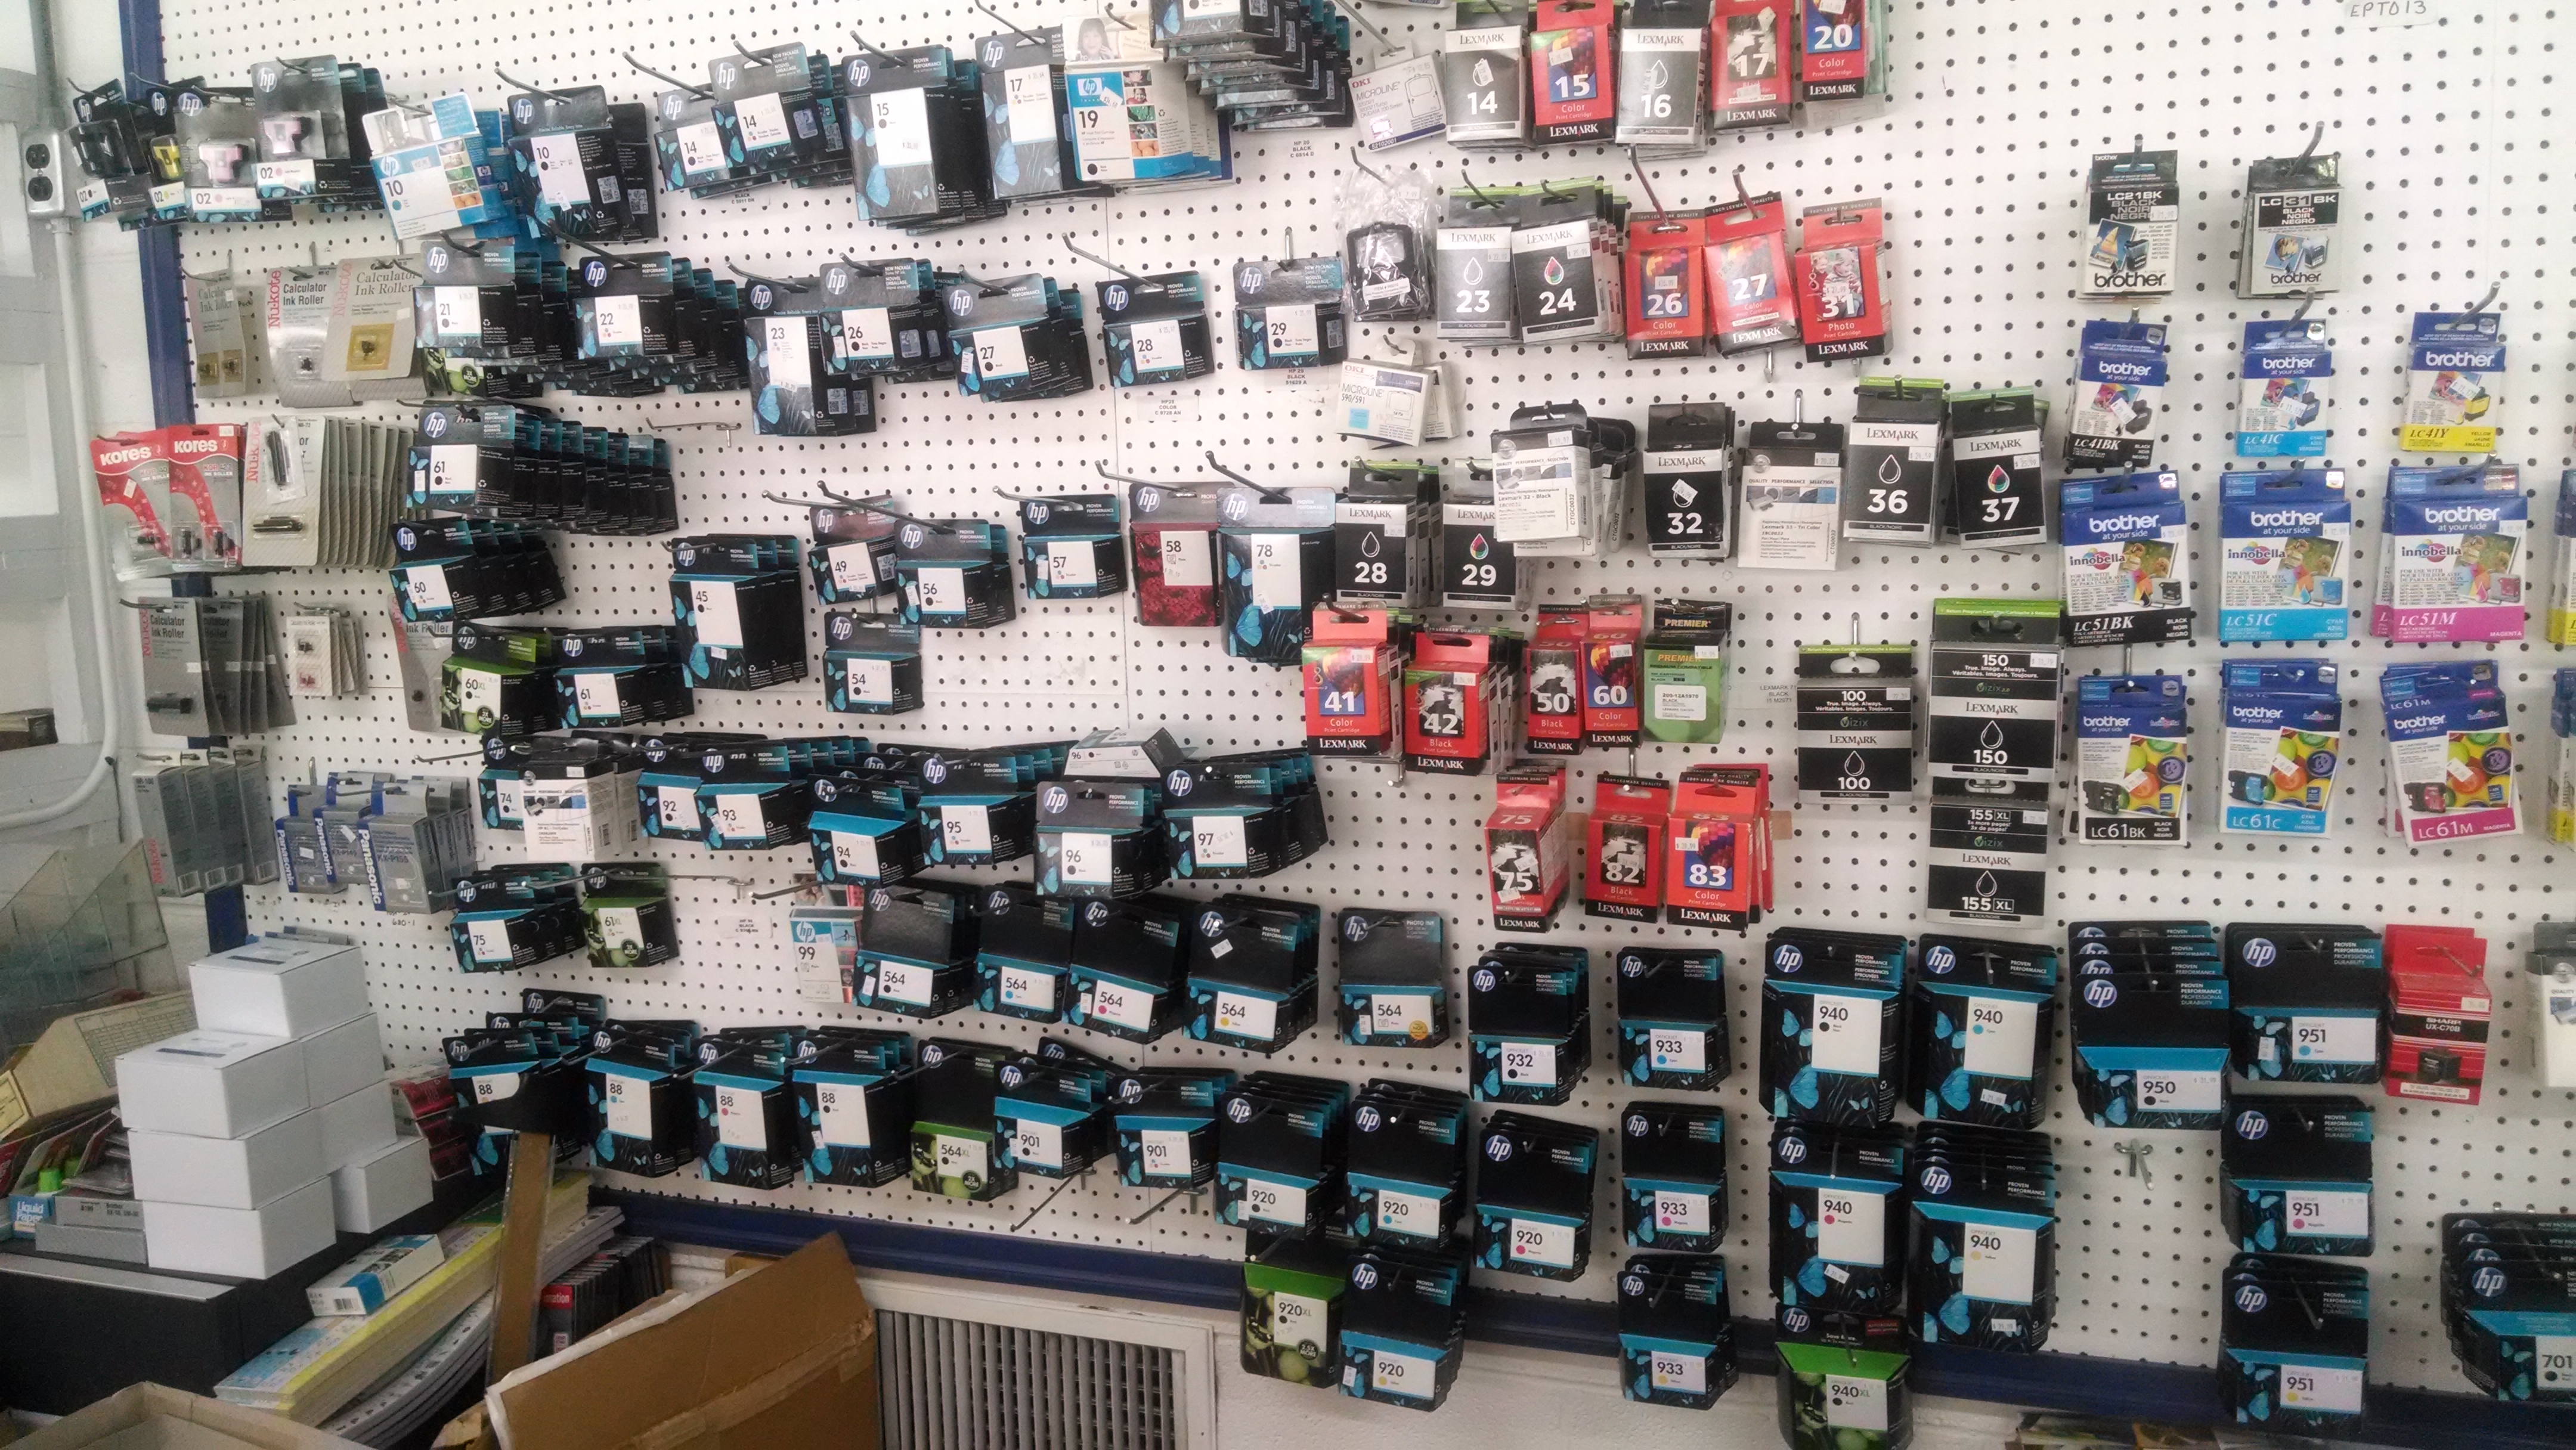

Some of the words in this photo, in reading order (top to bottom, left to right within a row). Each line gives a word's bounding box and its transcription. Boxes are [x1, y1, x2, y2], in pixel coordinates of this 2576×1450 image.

[1460, 34, 1504, 45] LEXMARK
[1814, 24, 1853, 49] 20
[1735, 53, 1769, 77] 17
[1010, 79, 1023, 92] 17
[1352, 78, 1371, 88] OKI
[1555, 73, 1590, 97] 15
[1810, 83, 1856, 95] LEXMARK
[877, 103, 889, 116] 15
[1467, 91, 1498, 115] 14
[1642, 94, 1671, 117] 16
[744, 116, 757, 128] 14
[1079, 110, 1098, 128] 19
[537, 147, 550, 159] 10
[684, 141, 697, 154] 14
[260, 167, 274, 179] 02
[385, 181, 403, 197] 10
[196, 193, 211, 205] 02
[2107, 191, 2162, 201] LC21BK
[2094, 272, 2165, 287] brother
[2271, 272, 2320, 284] brother
[283, 283, 326, 293] Calculator
[1733, 274, 1767, 300] 27
[283, 296, 296, 305] Ink
[299, 295, 324, 305] Roller
[1456, 290, 1490, 313] 23
[1539, 288, 1576, 315] 24
[1648, 293, 1683, 315] 26
[1822, 294, 1854, 317] 31
[439, 303, 450, 315] 21
[600, 314, 614, 325] 22
[771, 327, 785, 339] 23
[848, 327, 863, 339] 26
[1271, 323, 1287, 335] 29
[1137, 339, 1153, 352] 28
[1641, 341, 1689, 352] LEXMARK
[980, 346, 994, 359] 27
[2426, 351, 2493, 368] brother
[2100, 361, 2150, 376] brother
[1342, 383, 1382, 397] MICROLINE
[1342, 394, 1365, 404] 590/591
[434, 461, 445, 473] 61
[1867, 489, 1908, 514] 36
[1349, 509, 1392, 519] LEXMARK
[1982, 497, 2020, 522] 37
[2426, 507, 2498, 523] brother
[1667, 513, 1703, 534] 32
[2089, 515, 2159, 533] brother
[2296, 526, 2310, 534] side
[1166, 541, 1182, 553] 58
[1256, 545, 1272, 557] 78
[2070, 552, 2126, 566] innobella
[2228, 549, 2285, 561] innobella
[835, 561, 847, 572] 49
[1052, 556, 1066, 568] 57
[1354, 562, 1388, 584] 28
[1462, 564, 1497, 586] 29
[414, 582, 426, 593] 60
[924, 583, 937, 594] 56
[696, 591, 708, 602] 45
[1982, 655, 2009, 665] 150
[852, 674, 866, 685] 54
[580, 688, 591, 699] 61
[1593, 687, 1627, 705] 60
[1324, 692, 1354, 712] 41
[1537, 693, 1569, 713] 50
[1423, 714, 1460, 735] 42
[2084, 716, 2131, 729] brother
[1319, 738, 1367, 750] LEXMARK
[1429, 739, 1453, 748] Black
[1829, 735, 1877, 745] LEXMARK
[1417, 756, 1463, 770] LEXMARK
[1974, 750, 2008, 764] 150
[1838, 777, 1871, 789] 100
[500, 794, 512, 804] 74
[663, 801, 676, 811] 92
[723, 810, 736, 820] 93
[1970, 809, 1992, 820] 155
[947, 822, 962, 834] 95
[315, 818, 333, 875] Panasonic
[1198, 834, 1213, 846] 97
[837, 845, 851, 858] 94
[1066, 850, 1081, 862] 96
[1962, 853, 2011, 865] LEXMARK
[359, 829, 382, 904] Panasonic
[1606, 863, 1639, 884] 82
[1690, 865, 1726, 886] 83
[1501, 872, 1532, 891] 75
[1962, 897, 1991, 910] 155
[1996, 900, 2012, 909] XL
[605, 916, 621, 927] 61XL
[1681, 909, 1731, 922] LEXMARK
[473, 935, 486, 946] 75
[798, 947, 815, 959] 99
[884, 971, 905, 985] 564
[1005, 978, 1027, 991] 564
[1100, 993, 1122, 1006] 564
[1221, 1003, 1245, 1017] 564
[1377, 1005, 1402, 1015] 564
[1820, 1006, 1848, 1021] 940
[1974, 1009, 2002, 1024] 940
[2299, 1029, 2326, 1042] 951
[1656, 1040, 1682, 1053] 933
[1507, 1054, 1533, 1067] 932
[479, 1085, 493, 1095] 88
[610, 1084, 623, 1095] 88
[2143, 1082, 2176, 1093] 950
[720, 1095, 733, 1107] 88
[822, 1093, 835, 1104] 88
[1021, 1136, 1040, 1148] 901
[1147, 1145, 1167, 1157] 901
[1252, 1191, 1276, 1204] 920
[1383, 1201, 1408, 1215] 920
[1661, 1202, 1687, 1216] 933
[1824, 1201, 1852, 1214] 940
[2292, 1203, 2320, 1216] 951
[1516, 1231, 1543, 1245] 920
[1971, 1235, 2001, 1250] 940
[1657, 1361, 1683, 1375] 933
[2543, 1355, 2572, 1368] 701
[1379, 1363, 1404, 1377] 920
[2287, 1377, 2314, 1390] 951
